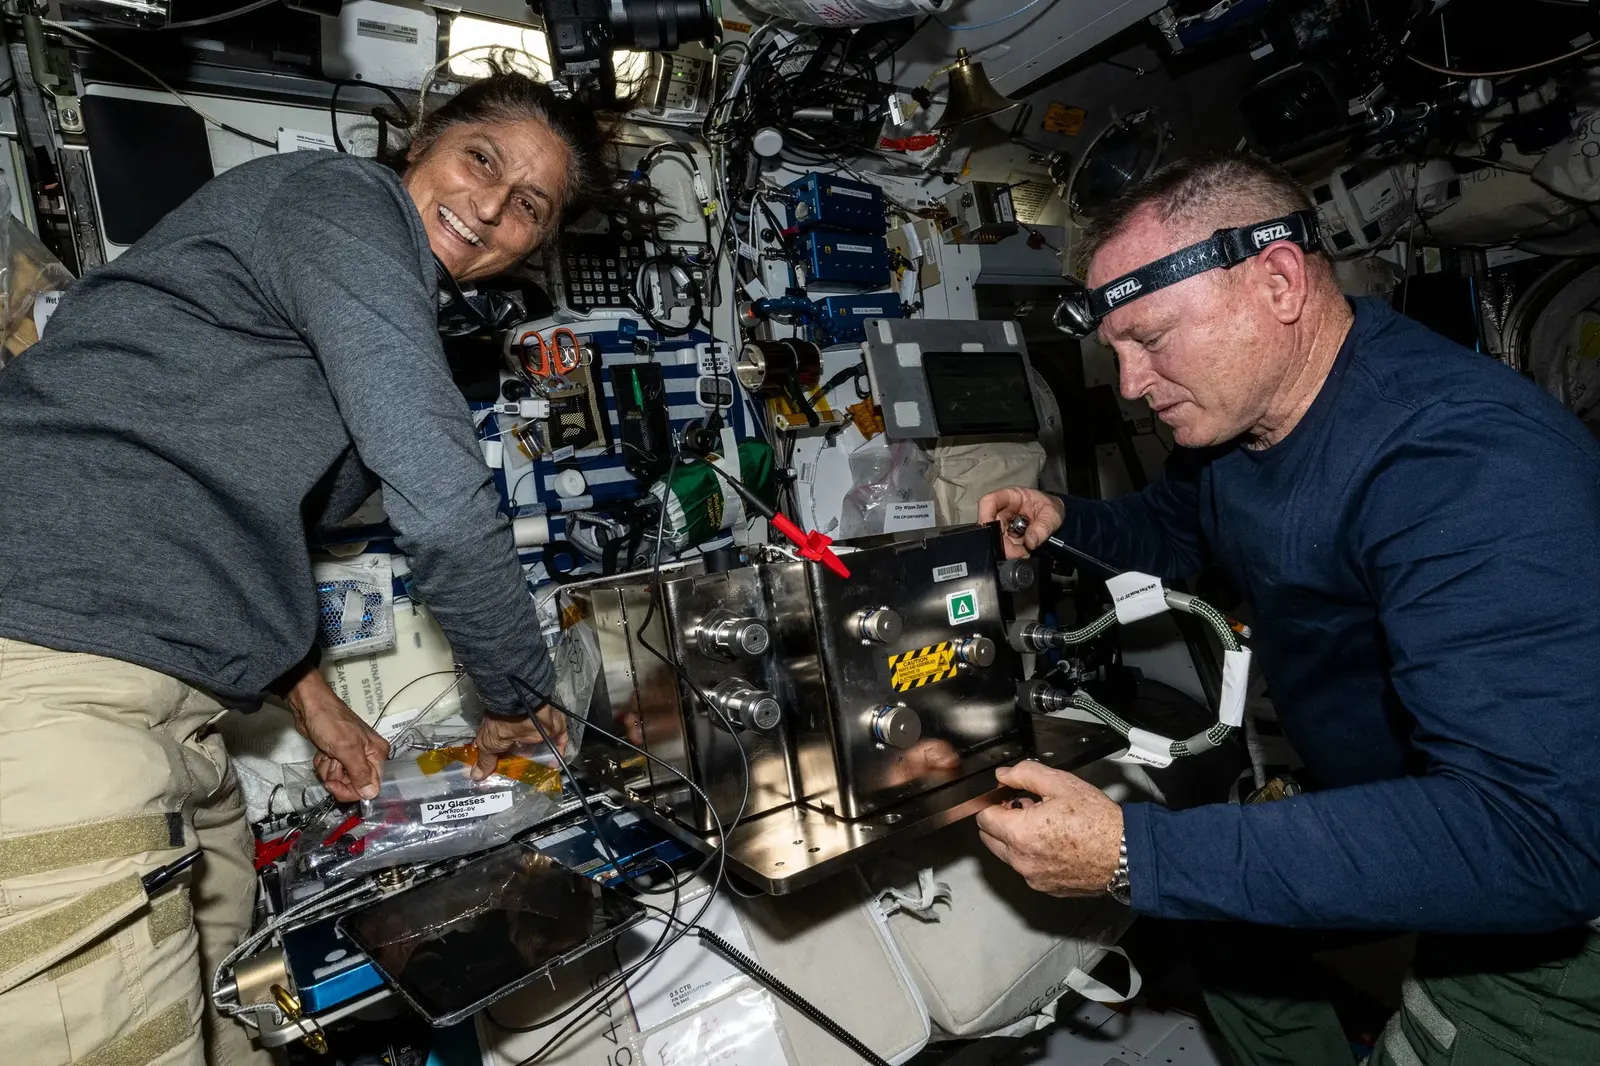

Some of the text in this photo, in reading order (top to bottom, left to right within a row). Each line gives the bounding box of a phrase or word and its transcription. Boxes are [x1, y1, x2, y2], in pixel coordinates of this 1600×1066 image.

[1254, 224, 1292, 249] PETZL
[1170, 248, 1218, 272] TIKKA
[1105, 279, 1142, 307] PETZL
[903, 656, 928, 667] CAUTION
[362, 678, 375, 715] STATION
[448, 797, 485, 808] Glasses
[670, 983, 692, 998] 0.5 CTB
